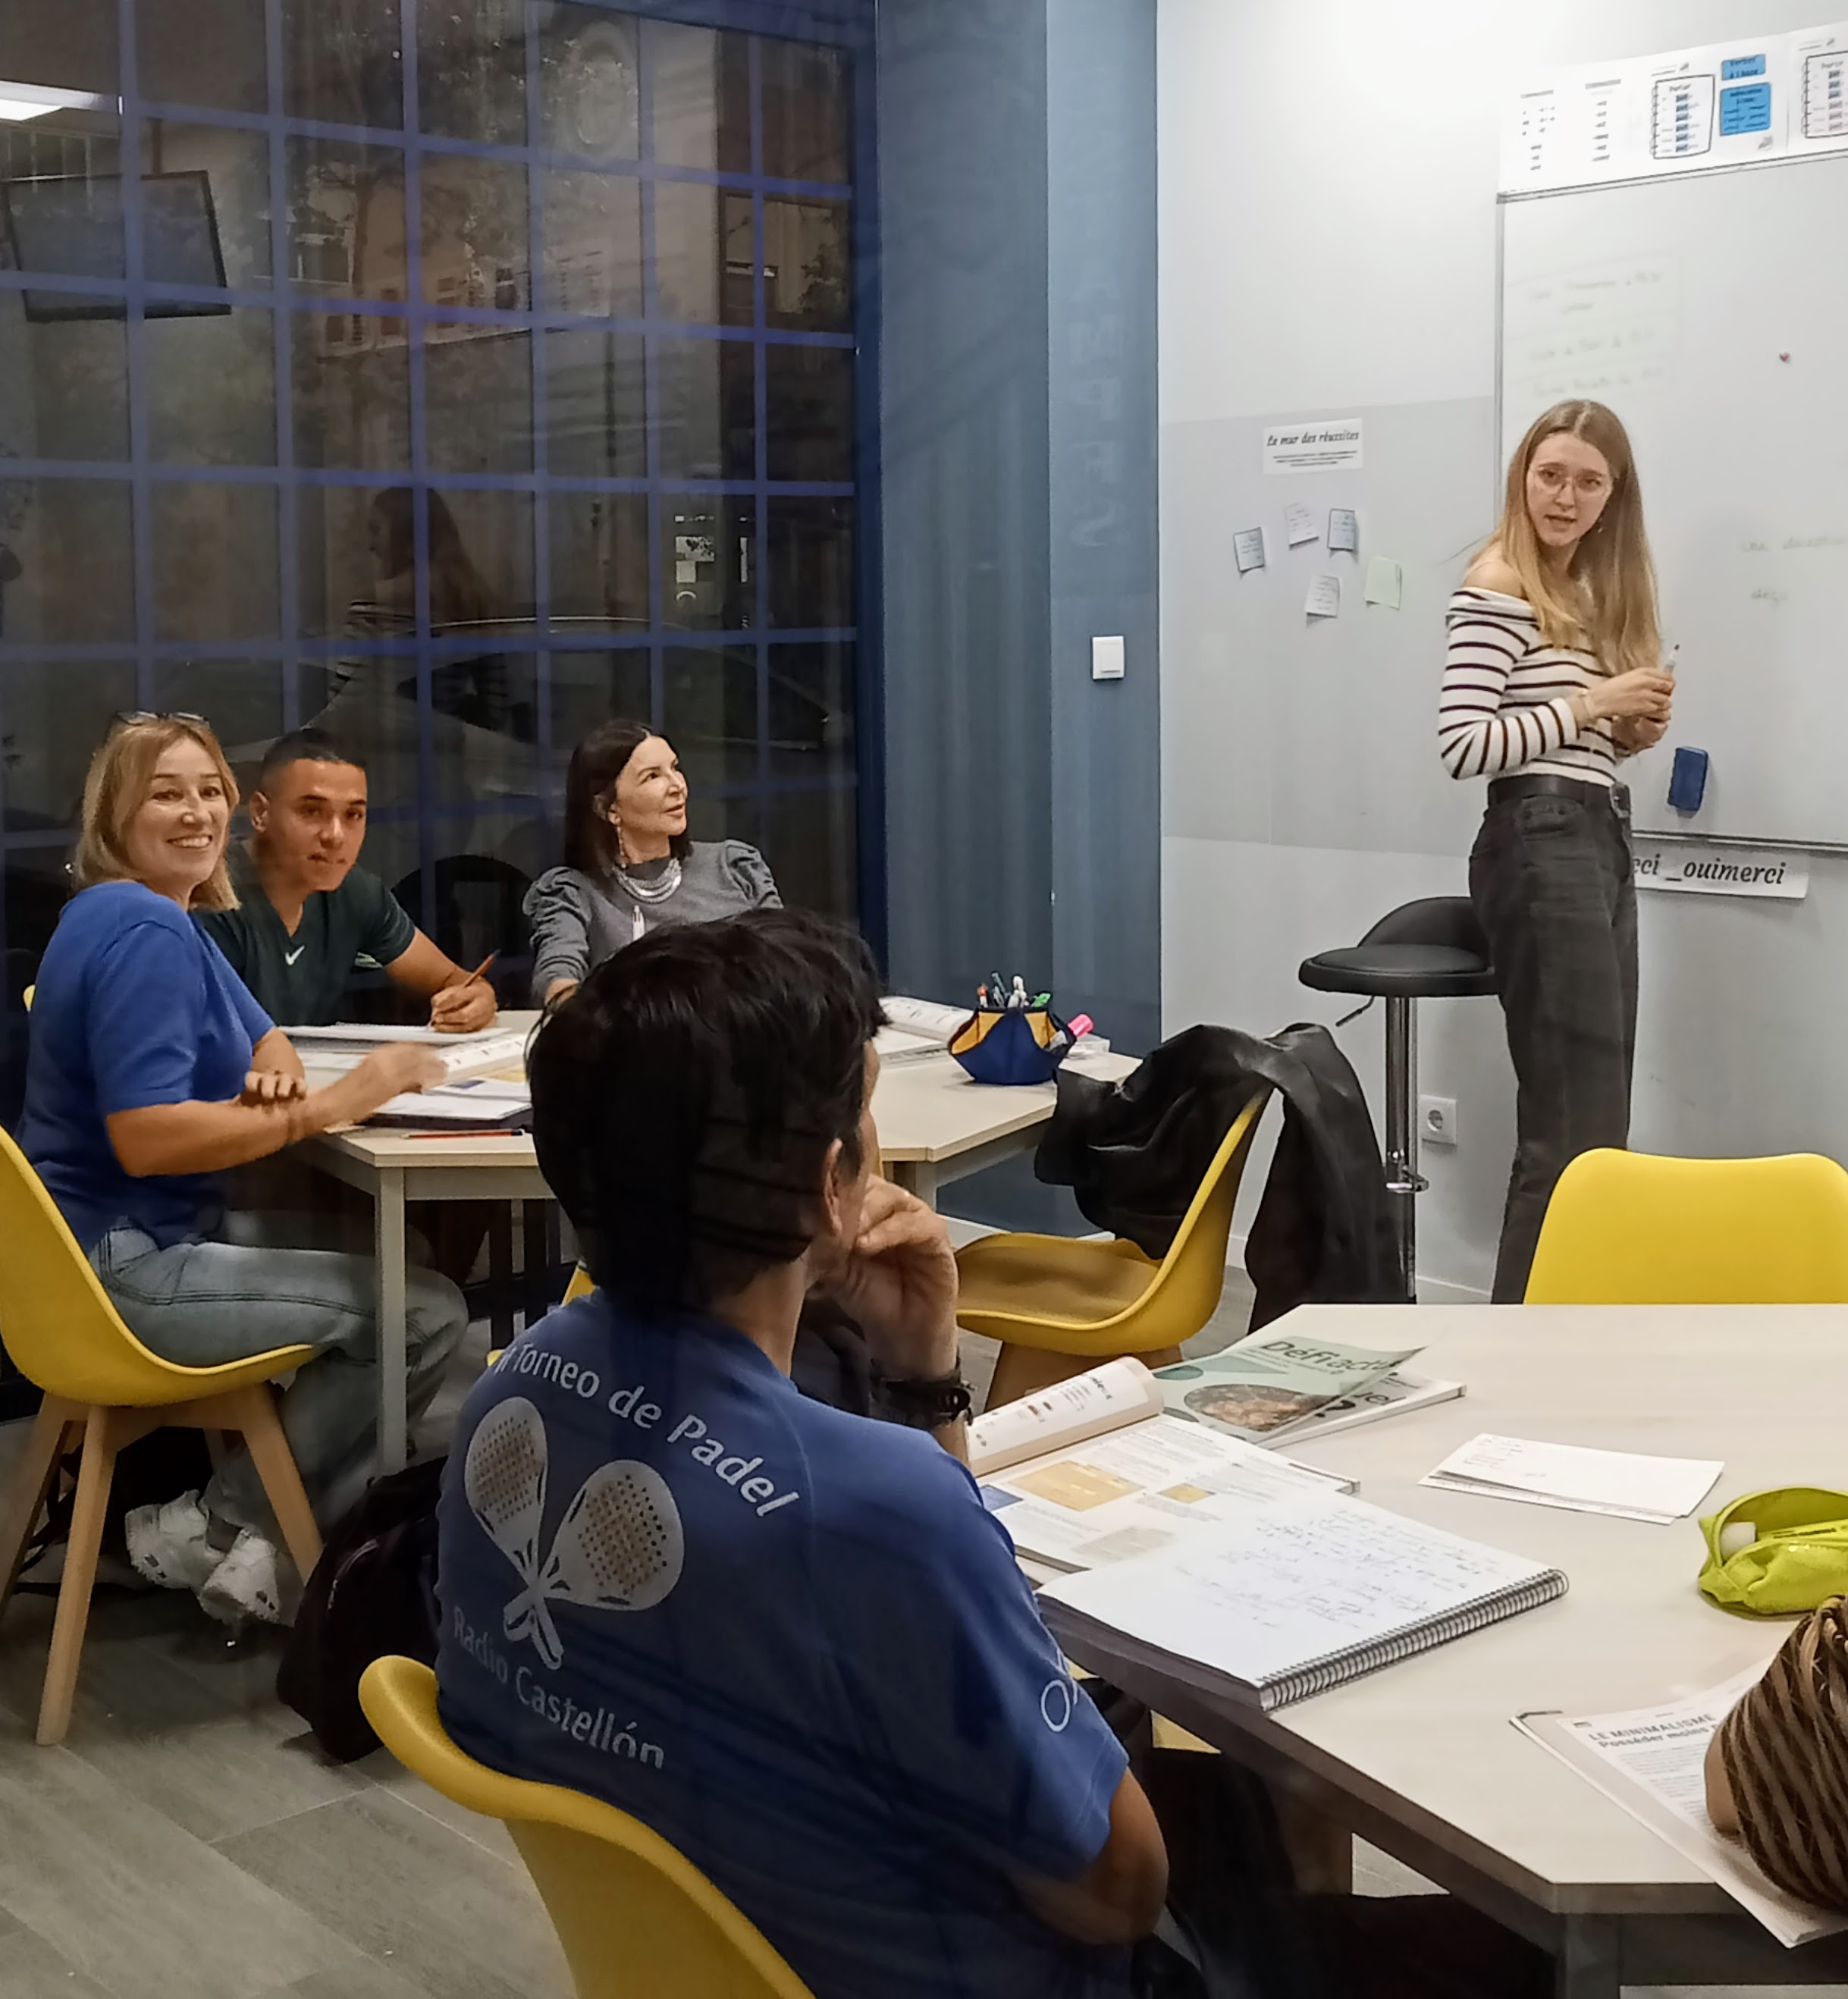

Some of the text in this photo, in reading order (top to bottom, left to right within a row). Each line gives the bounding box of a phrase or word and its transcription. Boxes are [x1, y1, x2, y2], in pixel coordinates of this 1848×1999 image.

[1267, 429, 1360, 446] Le mur des réussites
[512, 1343, 600, 1398] Torneo
[608, 1385, 662, 1429] de
[667, 1414, 799, 1517] Padel
[454, 1605, 664, 1768] Radio Castellón
[1589, 1731, 1609, 1741] LE
[1609, 1713, 1716, 1737] MINIMALISME
